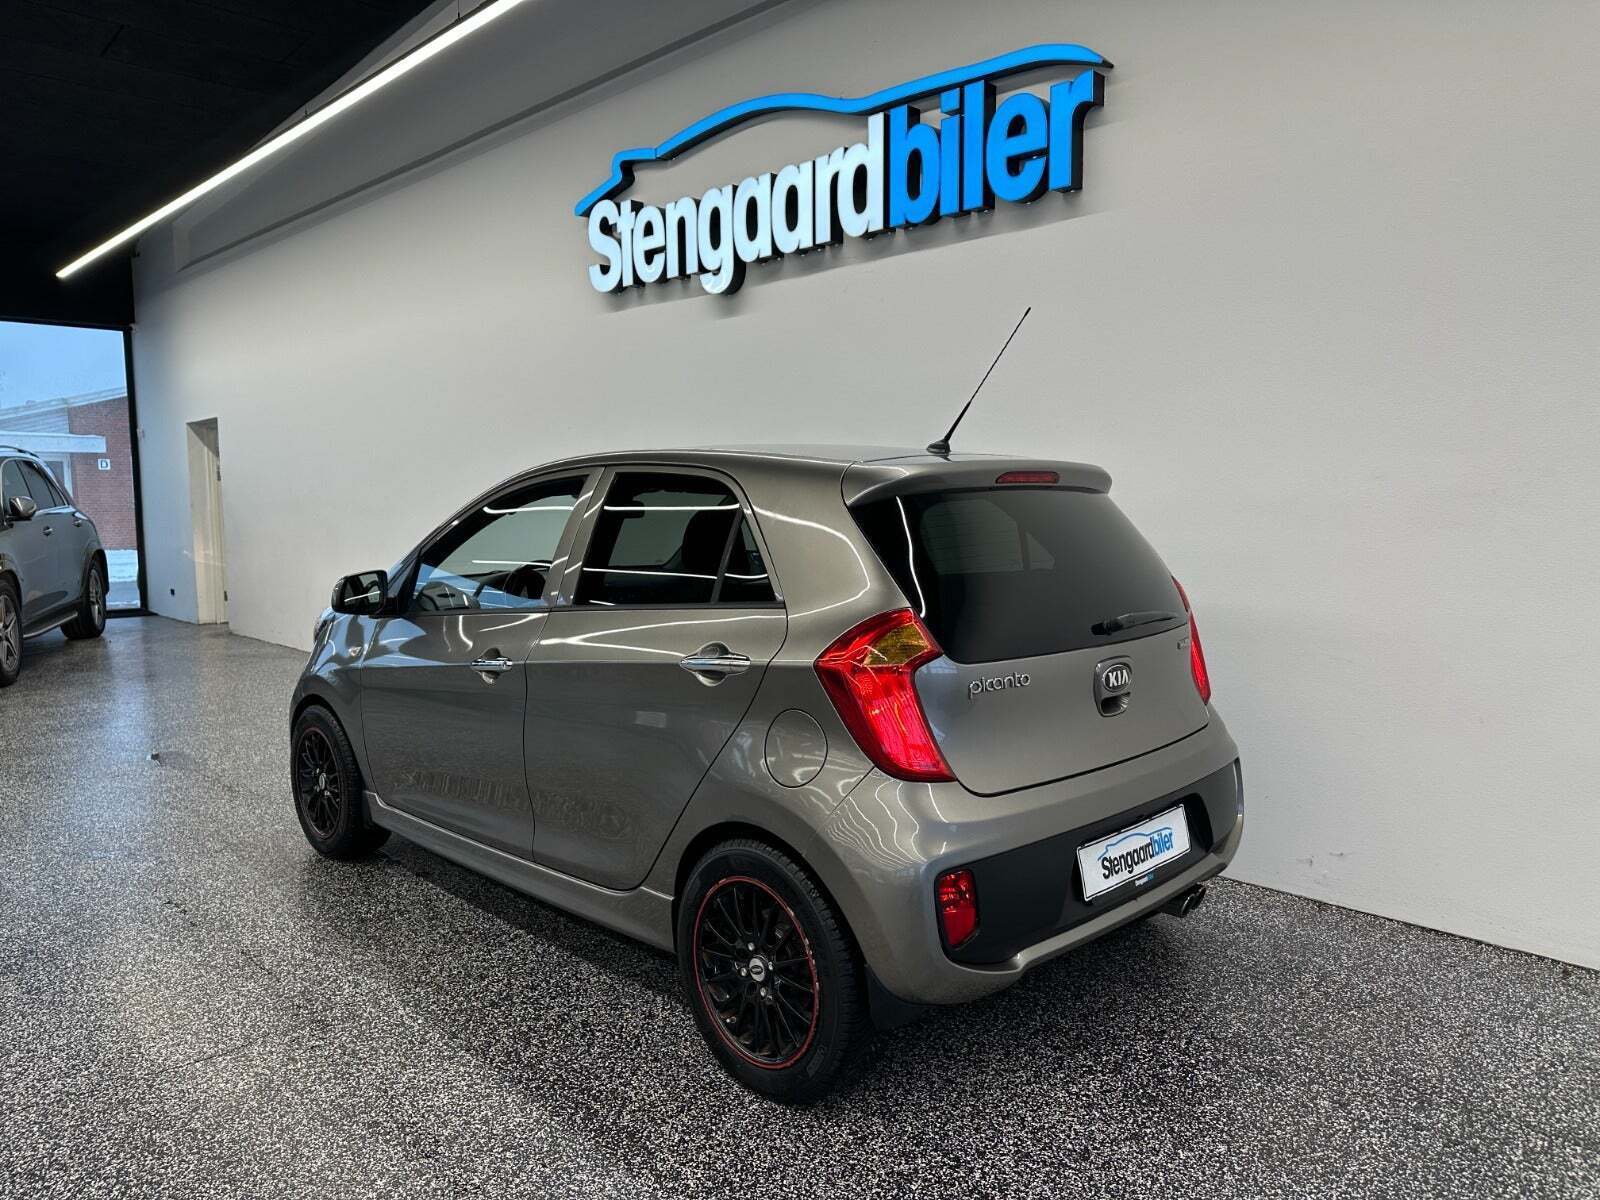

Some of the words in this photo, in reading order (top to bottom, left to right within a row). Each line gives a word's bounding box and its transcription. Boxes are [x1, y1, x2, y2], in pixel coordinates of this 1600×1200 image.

[588, 69, 1099, 294] Stengaardbiler
[100, 459, 109, 469] D
[969, 671, 1031, 700] picanto
[1107, 669, 1129, 687] KIA
[1101, 831, 1174, 880] Stengaardbiler
